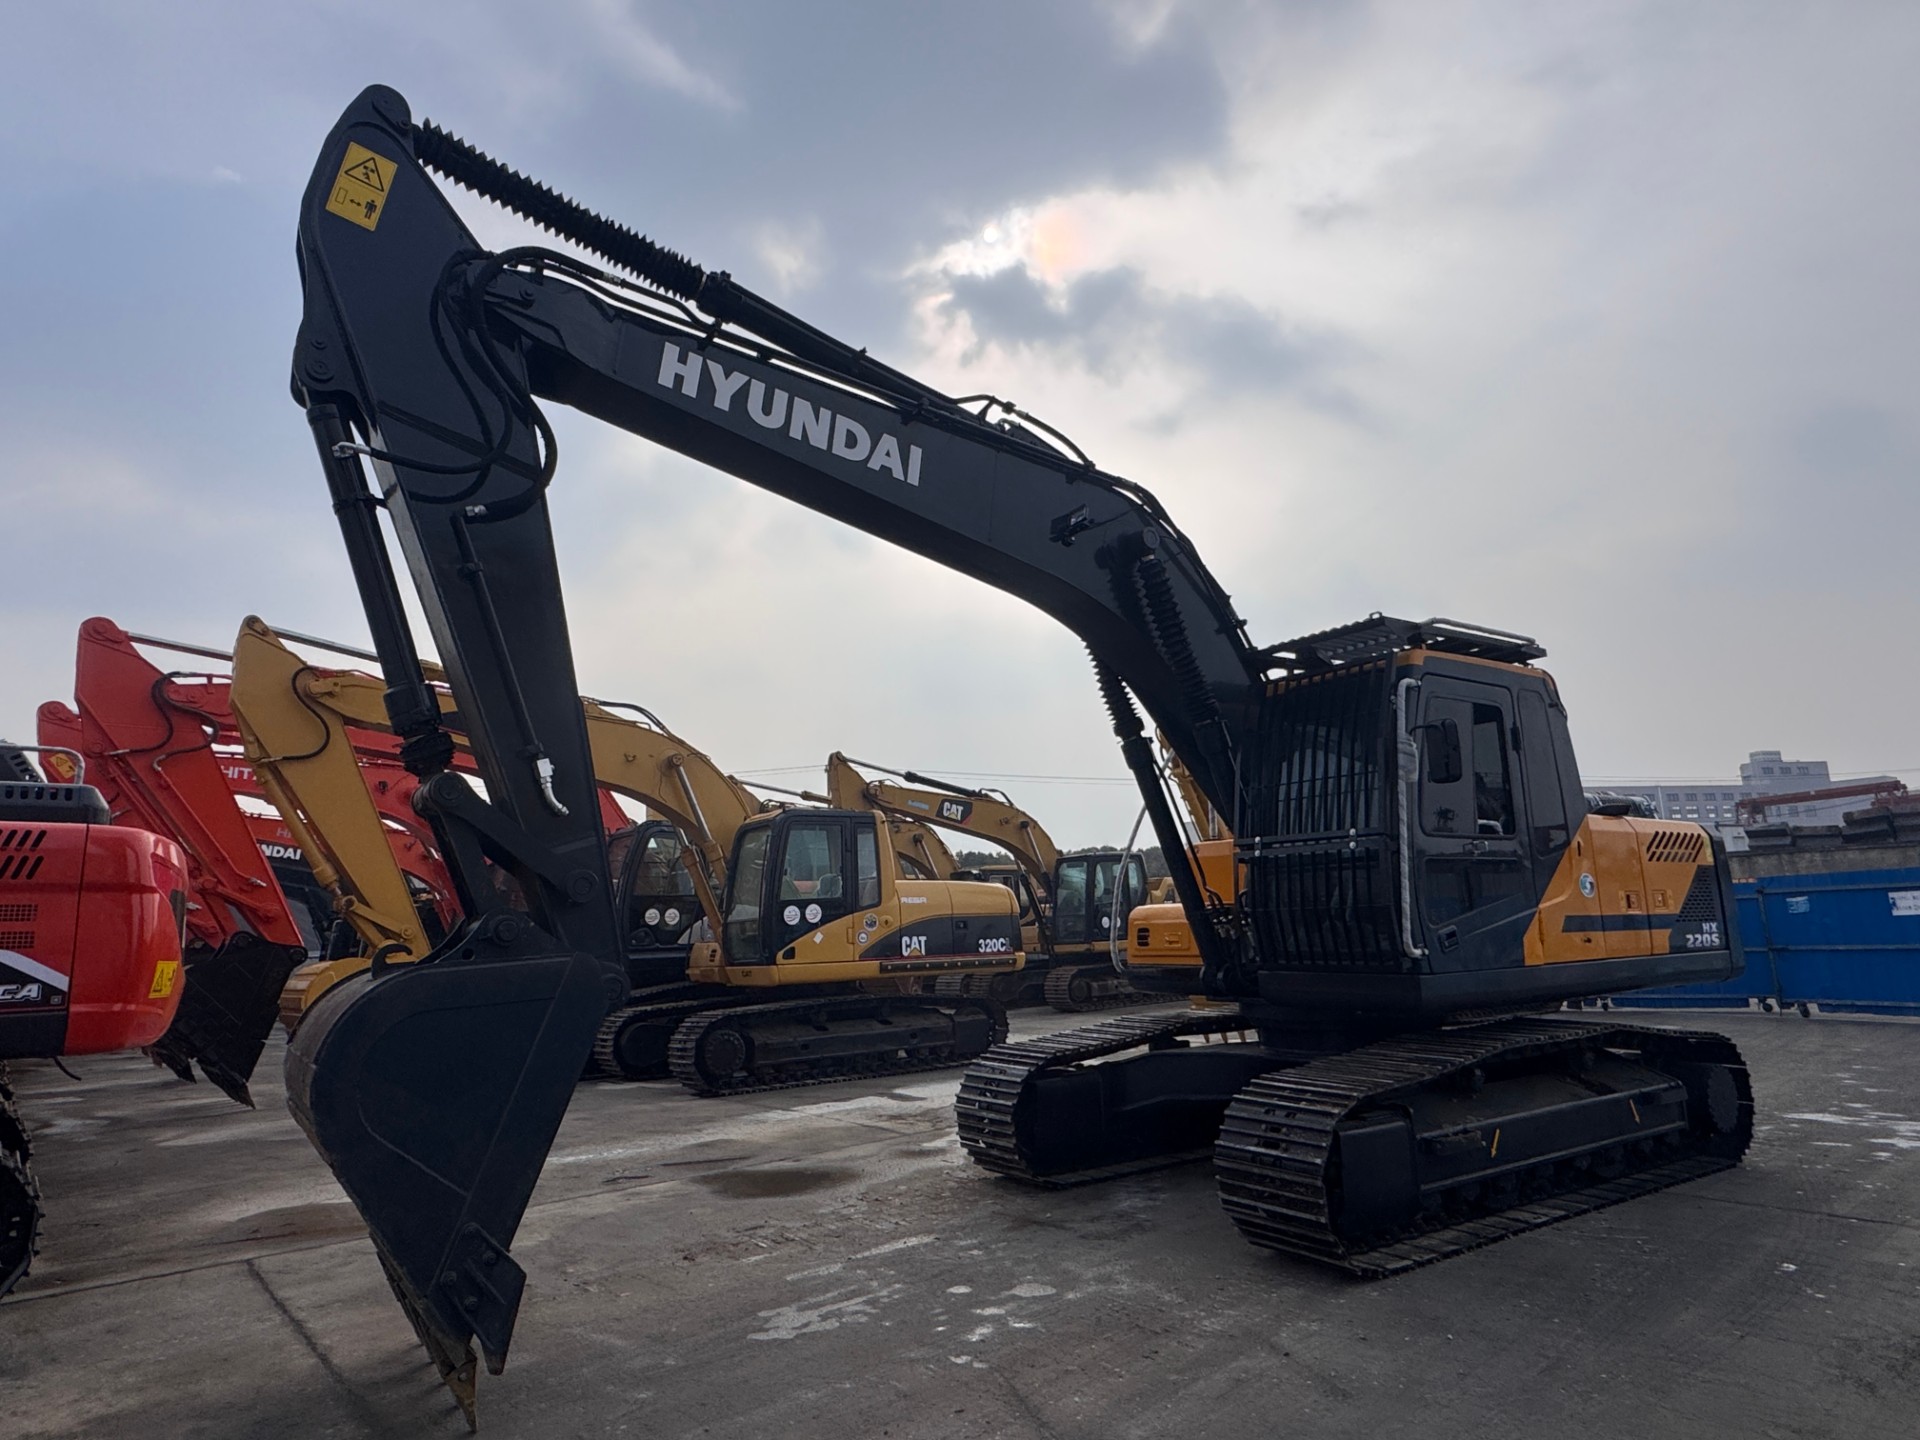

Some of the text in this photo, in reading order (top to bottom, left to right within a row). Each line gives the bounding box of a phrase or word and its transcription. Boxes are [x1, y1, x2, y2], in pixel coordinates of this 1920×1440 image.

[657, 341, 922, 487] HYUNDAI
[220, 765, 257, 780] HIT
[943, 801, 963, 821] CAT
[257, 843, 302, 861] NDAI
[1702, 922, 1717, 933] HX
[901, 936, 927, 956] CAT
[1685, 933, 1720, 948] 220S
